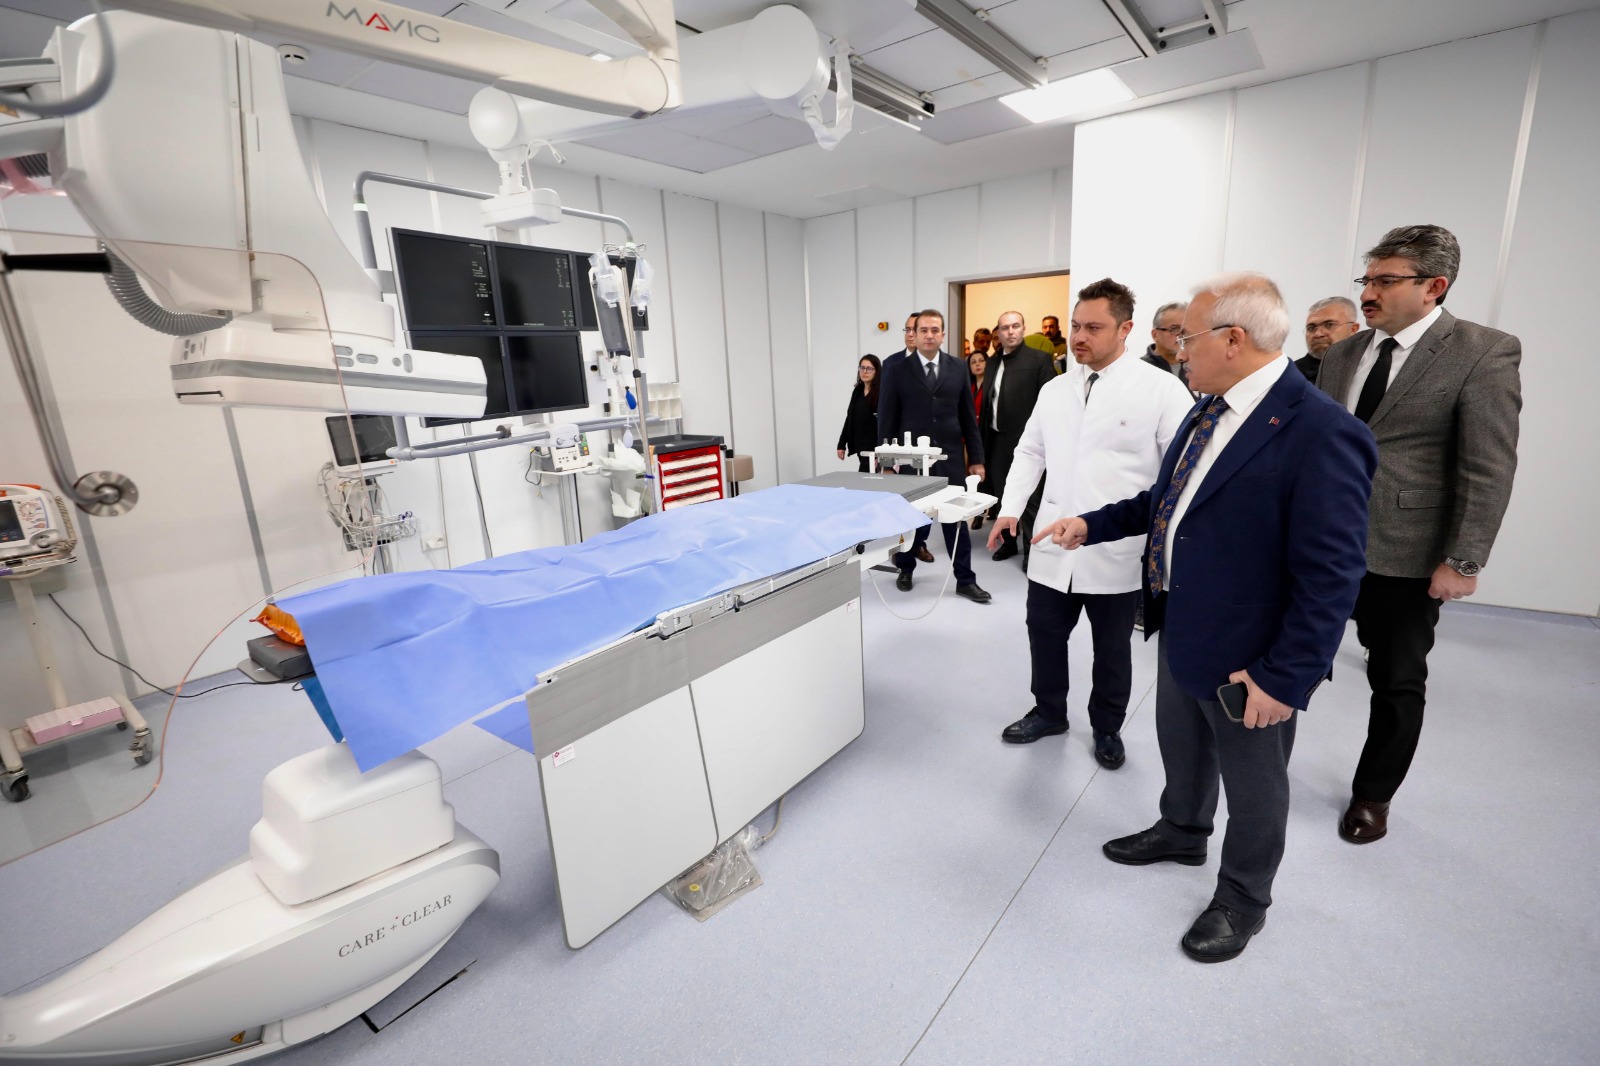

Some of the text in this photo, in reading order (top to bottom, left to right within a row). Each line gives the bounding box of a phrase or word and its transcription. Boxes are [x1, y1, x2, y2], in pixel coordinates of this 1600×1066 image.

[326, 1, 440, 43] MAVIG
[338, 927, 385, 957] CARE
[402, 896, 451, 926] CLEAR
